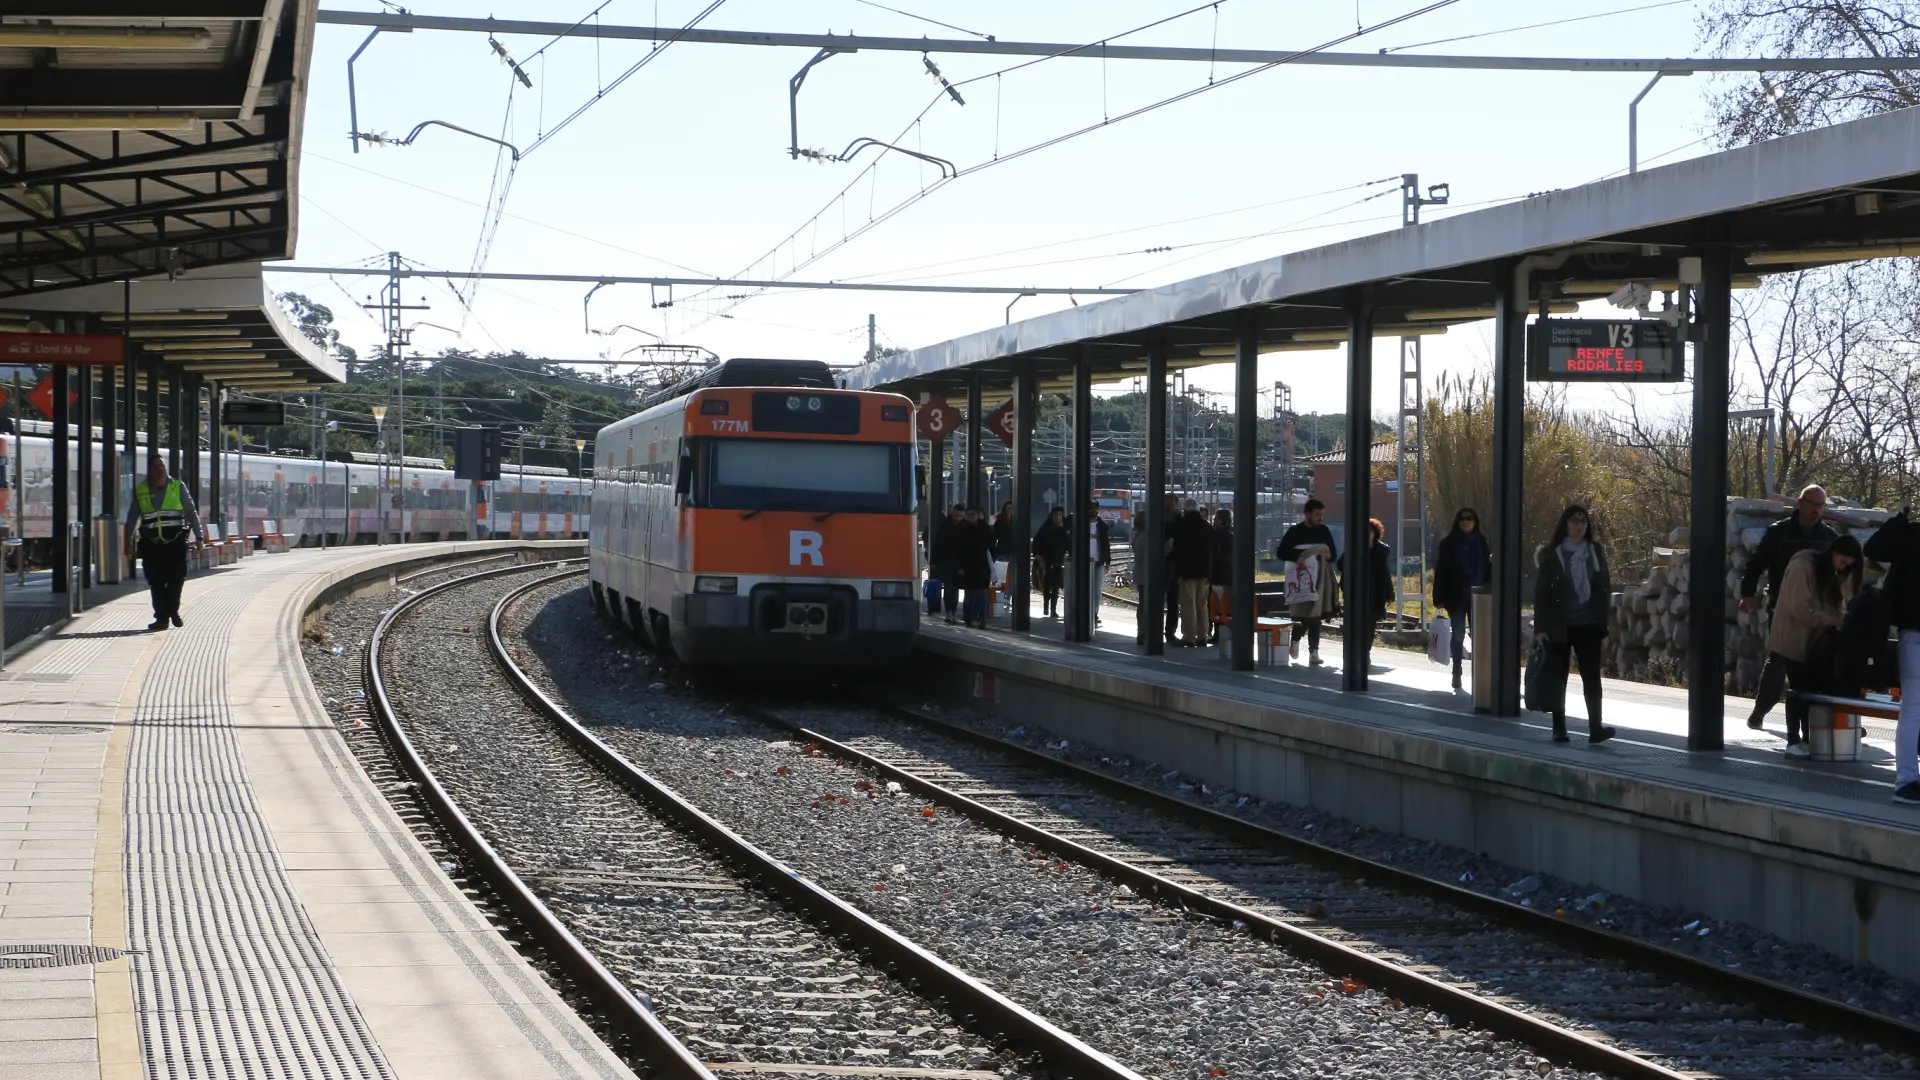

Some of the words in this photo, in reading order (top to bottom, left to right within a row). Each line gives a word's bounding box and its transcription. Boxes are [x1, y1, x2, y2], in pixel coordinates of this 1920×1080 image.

[1552, 335, 1580, 343] Destino
[1608, 324, 1633, 348] V3
[61, 343, 73, 354] de
[74, 344, 91, 355] Mar
[1577, 347, 1625, 359] RENFE
[1567, 359, 1644, 372] RODALIES
[711, 419, 749, 432] 177M
[929, 408, 943, 432] 3
[789, 530, 824, 567] R
